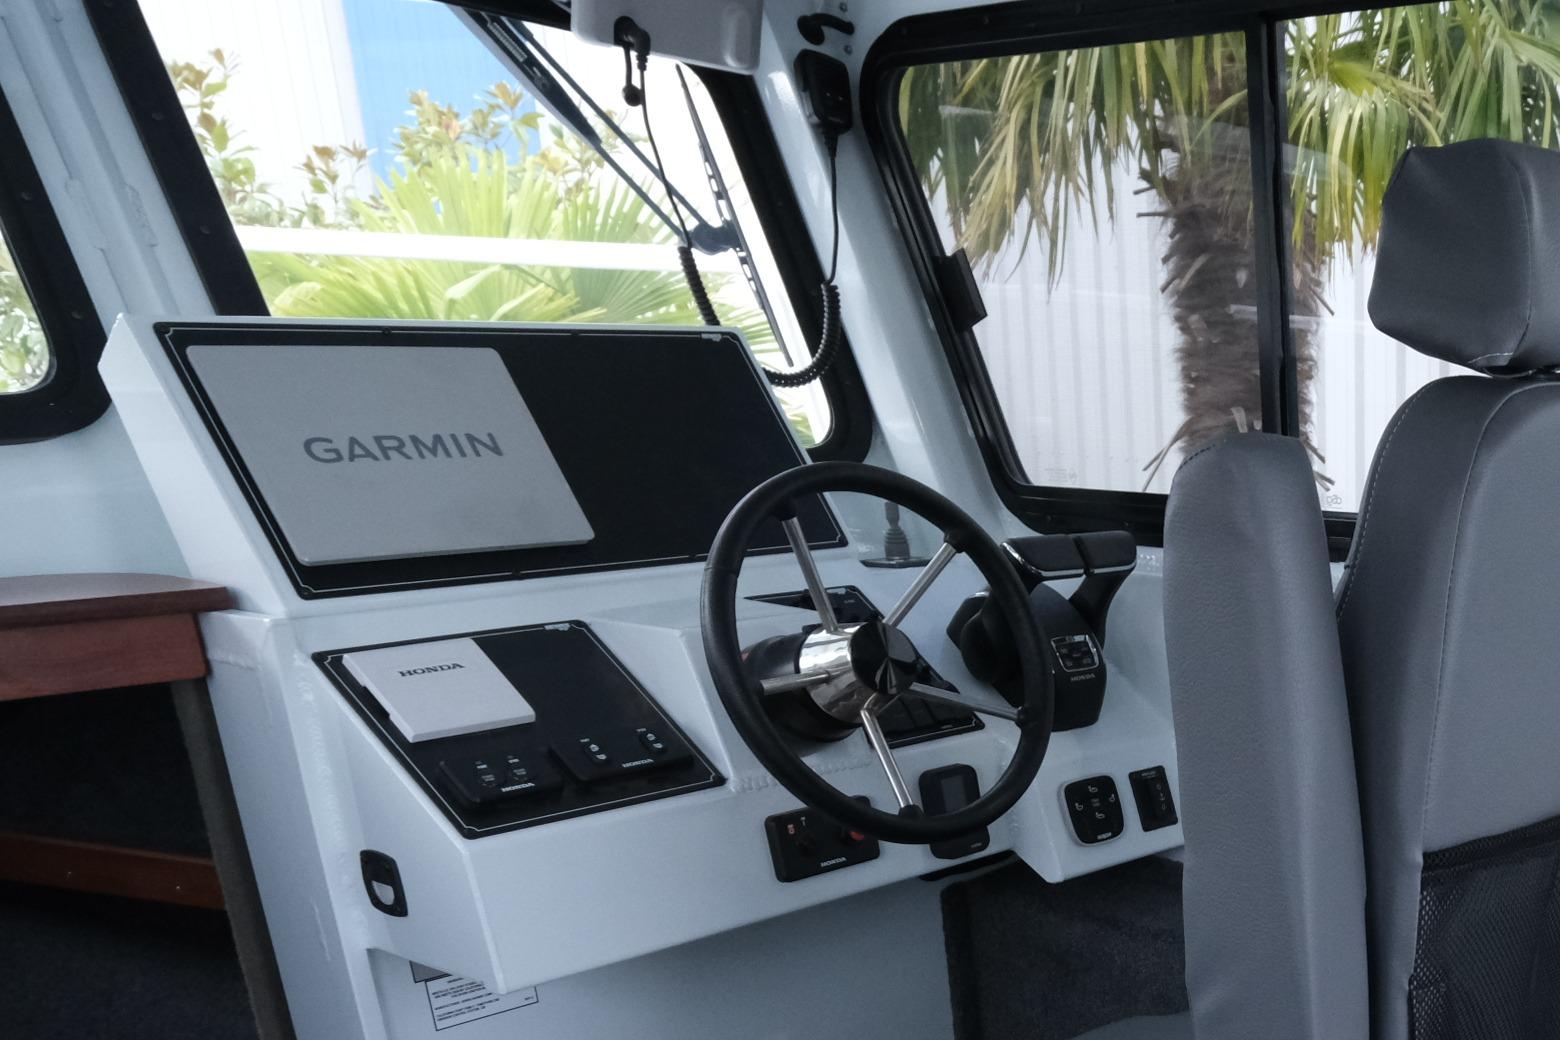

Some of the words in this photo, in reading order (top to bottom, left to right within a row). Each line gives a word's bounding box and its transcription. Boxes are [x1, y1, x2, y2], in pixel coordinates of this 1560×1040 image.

[303, 431, 504, 465] GARMIN
[397, 660, 466, 678] HONDA
[621, 757, 655, 769] HONDA
[501, 782, 536, 793] HONDA
[820, 856, 847, 868] HONDA
